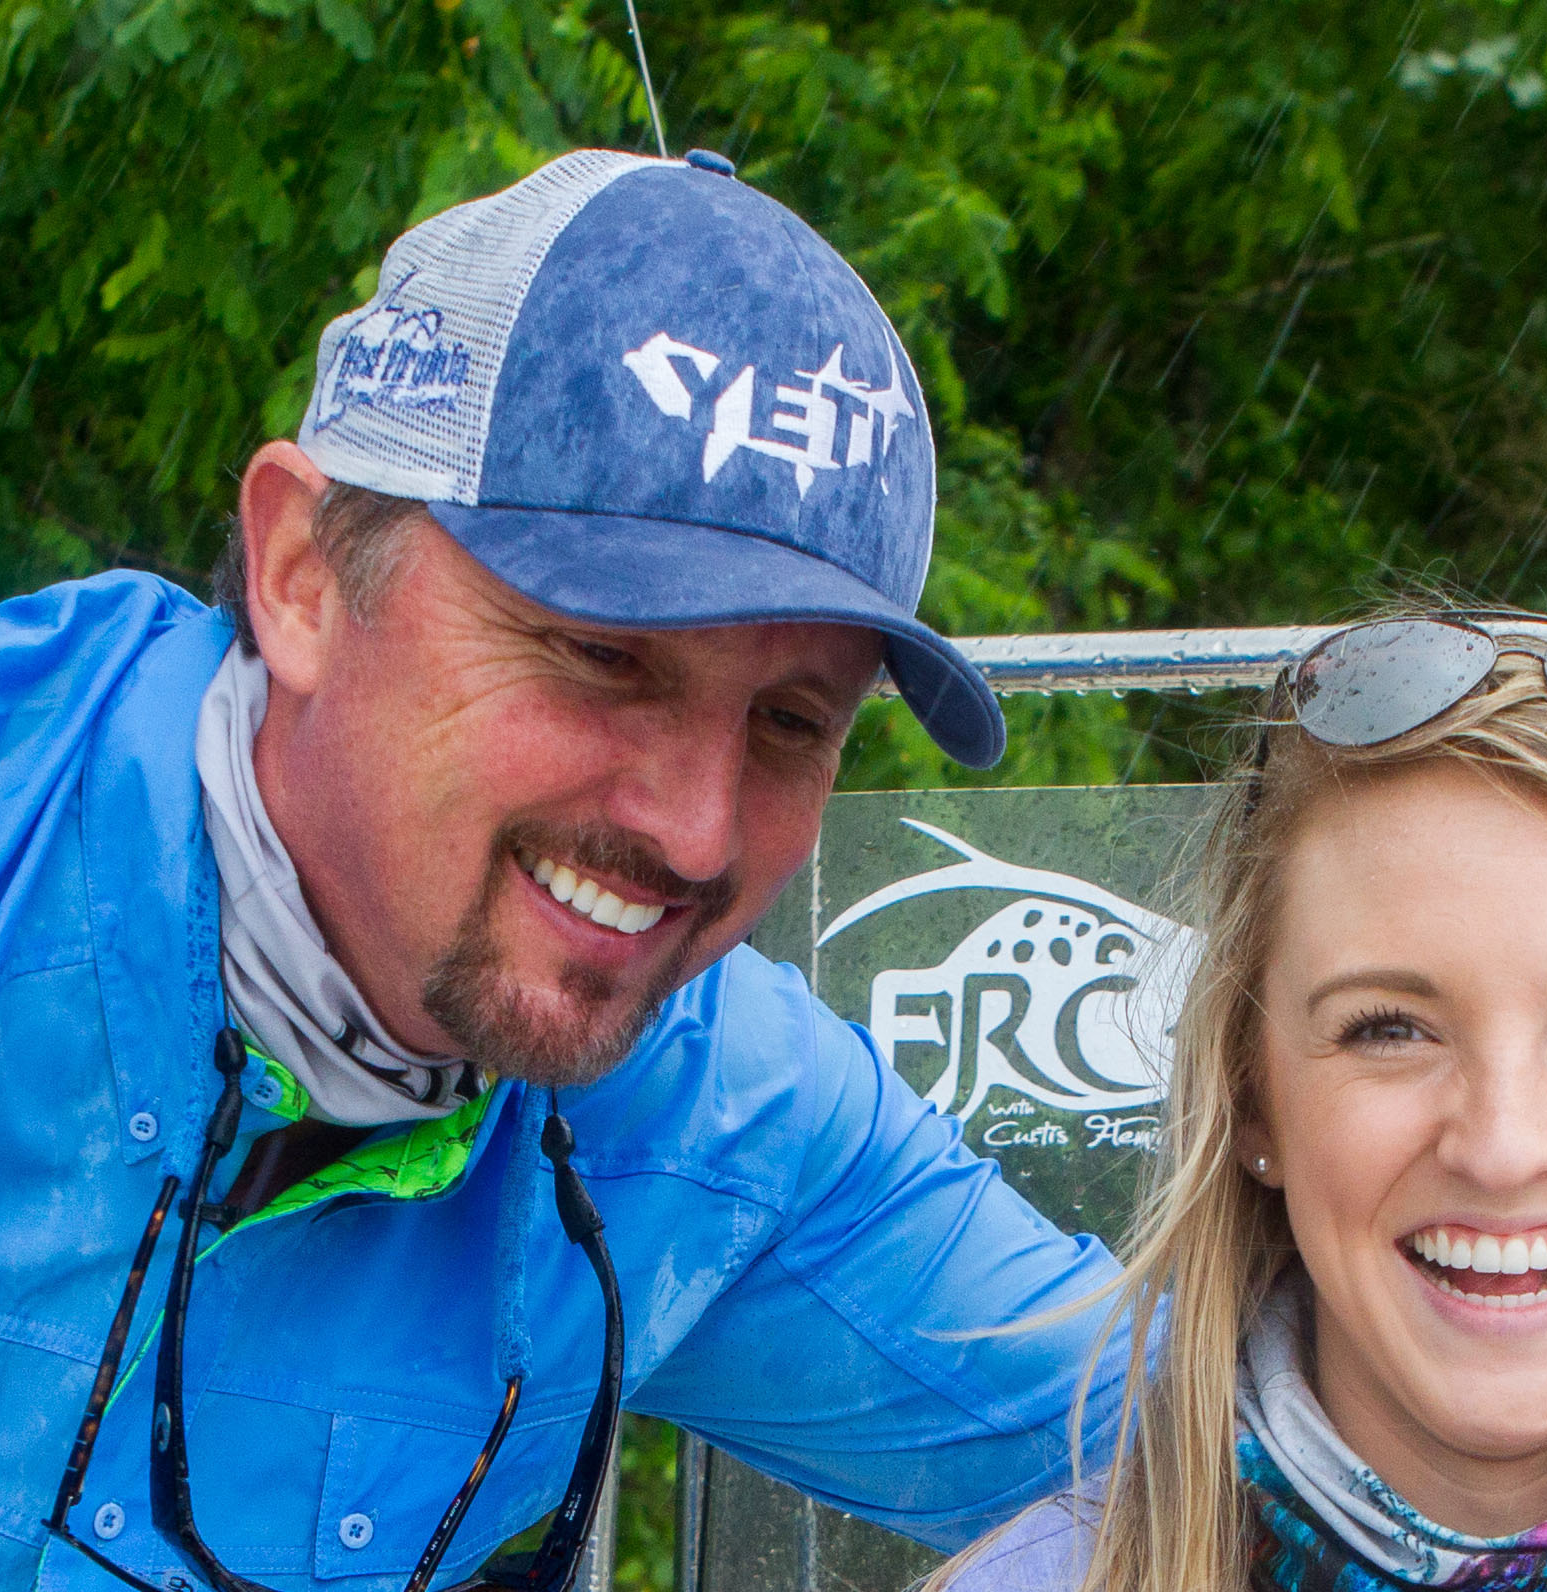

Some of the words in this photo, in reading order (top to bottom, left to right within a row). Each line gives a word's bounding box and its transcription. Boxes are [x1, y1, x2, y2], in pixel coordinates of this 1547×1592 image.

[642, 338, 898, 478] YETI
[988, 1098, 1036, 1117] with
[982, 1119, 1070, 1148] Curtis
